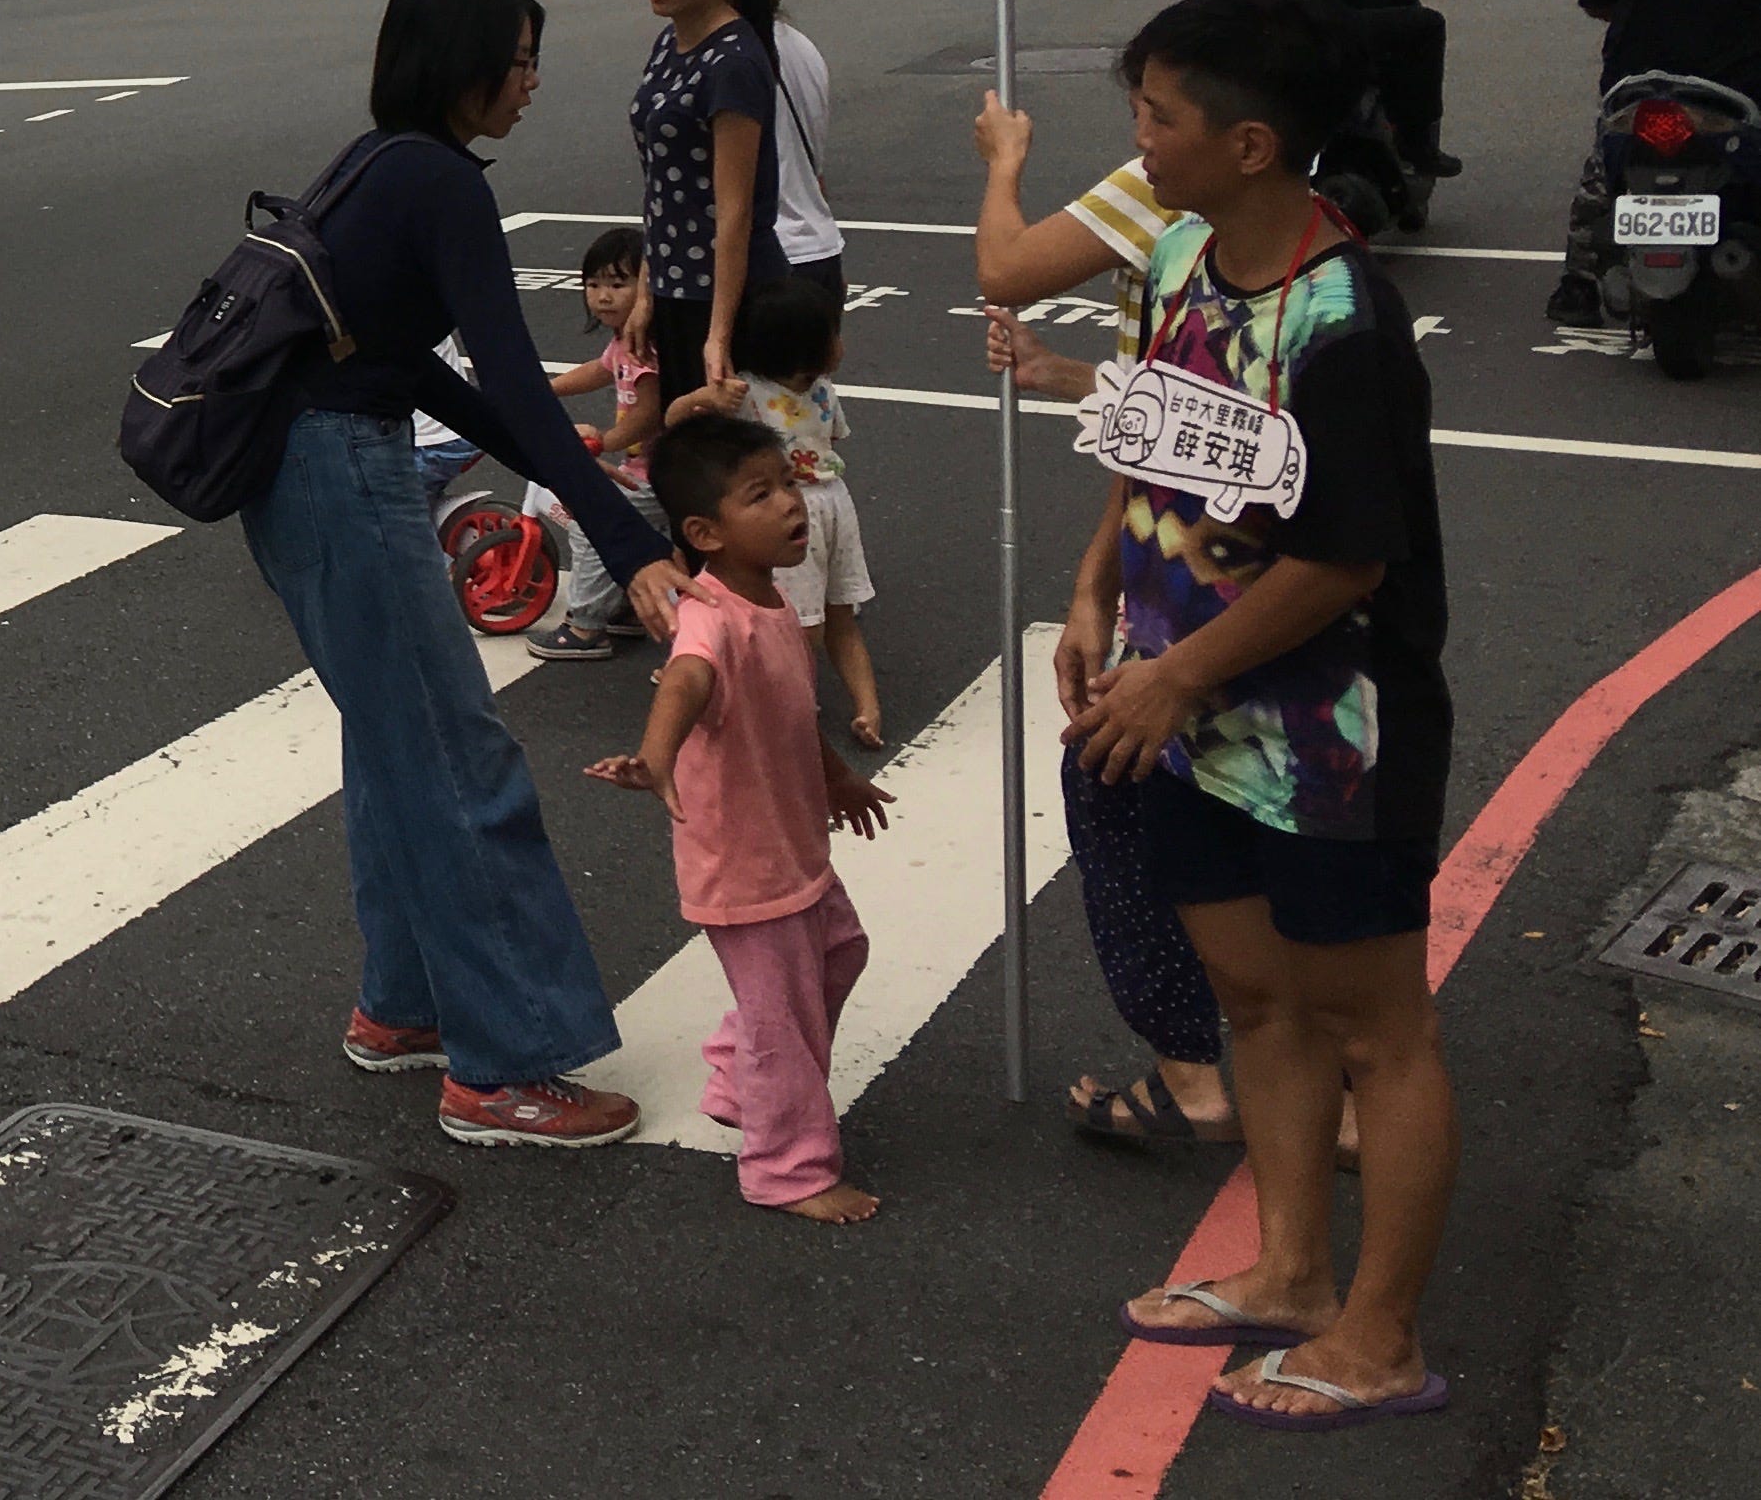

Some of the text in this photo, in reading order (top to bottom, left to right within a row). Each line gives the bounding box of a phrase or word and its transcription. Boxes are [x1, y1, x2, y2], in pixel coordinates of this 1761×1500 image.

[1617, 211, 1716, 237] 962-GXB
[1169, 393, 1265, 437] 台中大里霧峰
[1173, 421, 1261, 483] 薛安琪
